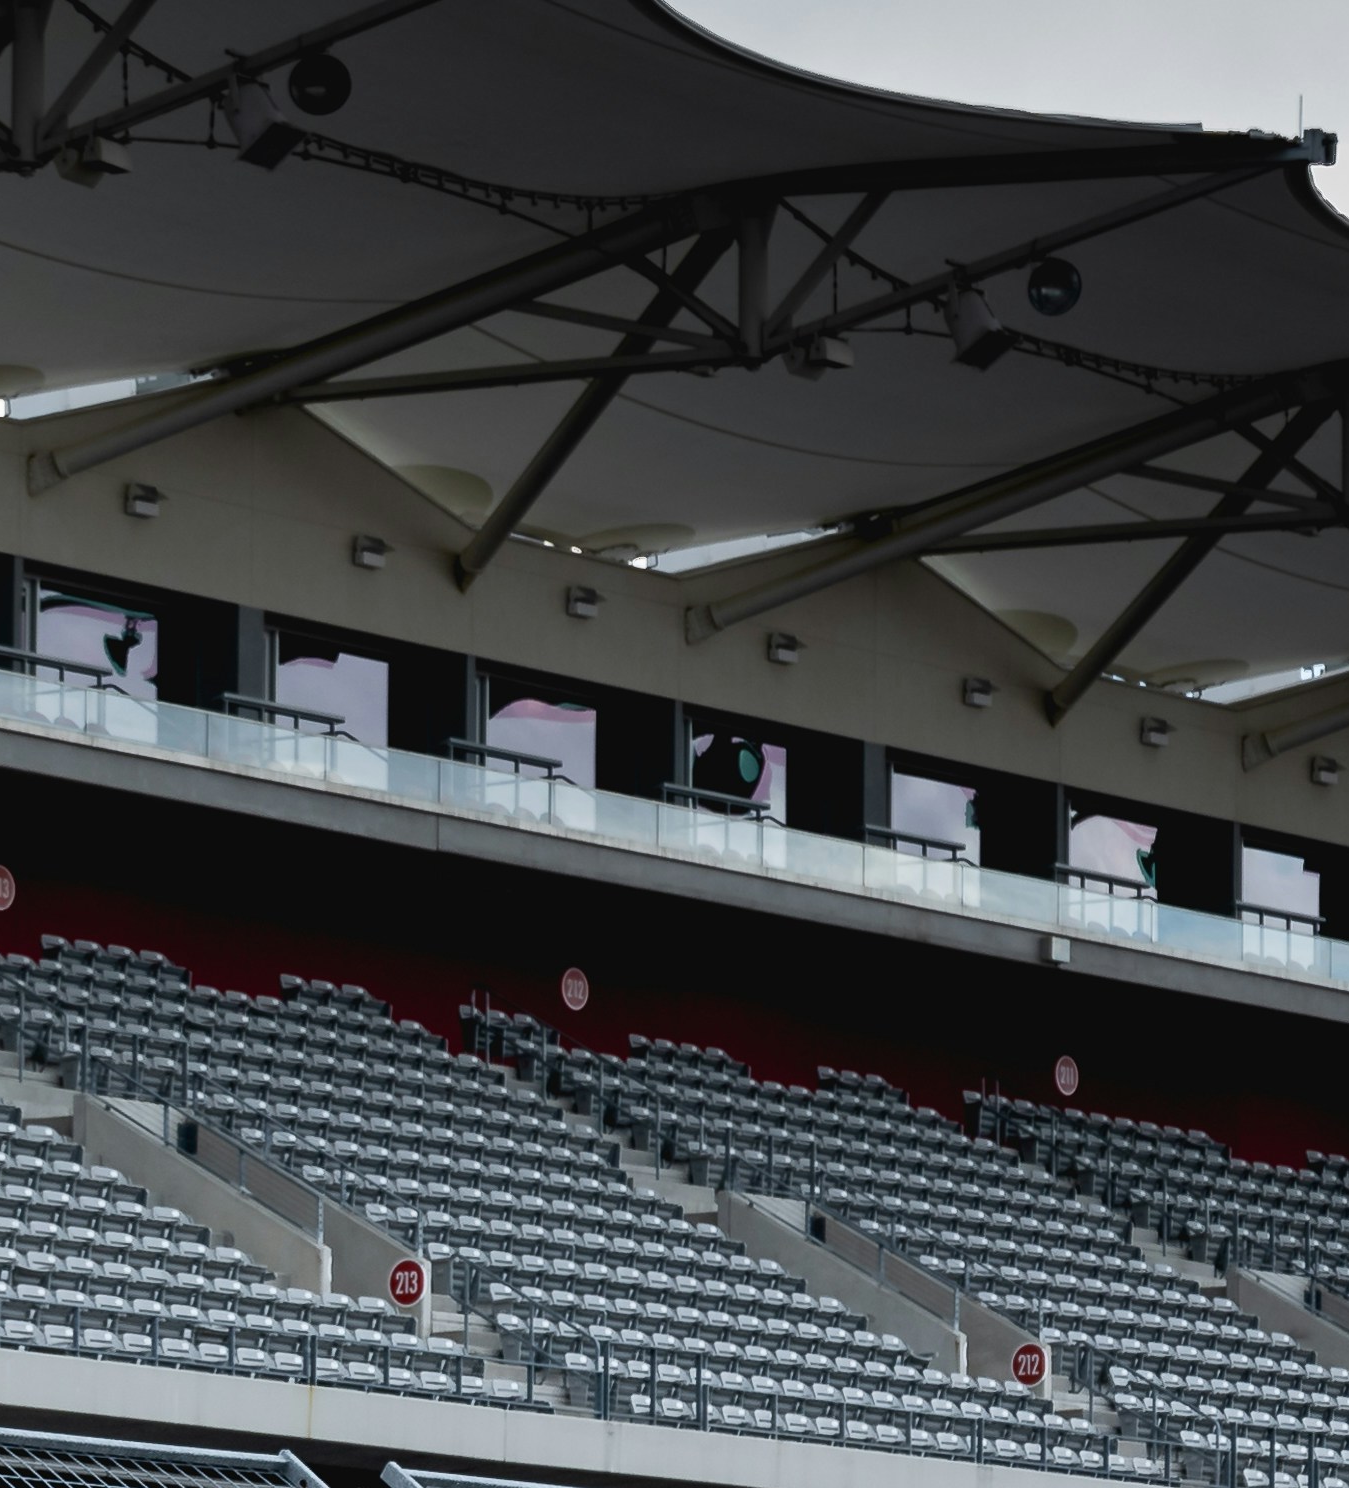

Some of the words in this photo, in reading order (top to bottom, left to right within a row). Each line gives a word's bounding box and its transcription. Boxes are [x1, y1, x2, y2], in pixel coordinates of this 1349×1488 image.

[567, 978, 584, 999] 212
[1060, 1066, 1074, 1085] 211
[395, 1271, 418, 1295] 213
[1018, 1353, 1040, 1376] 212
